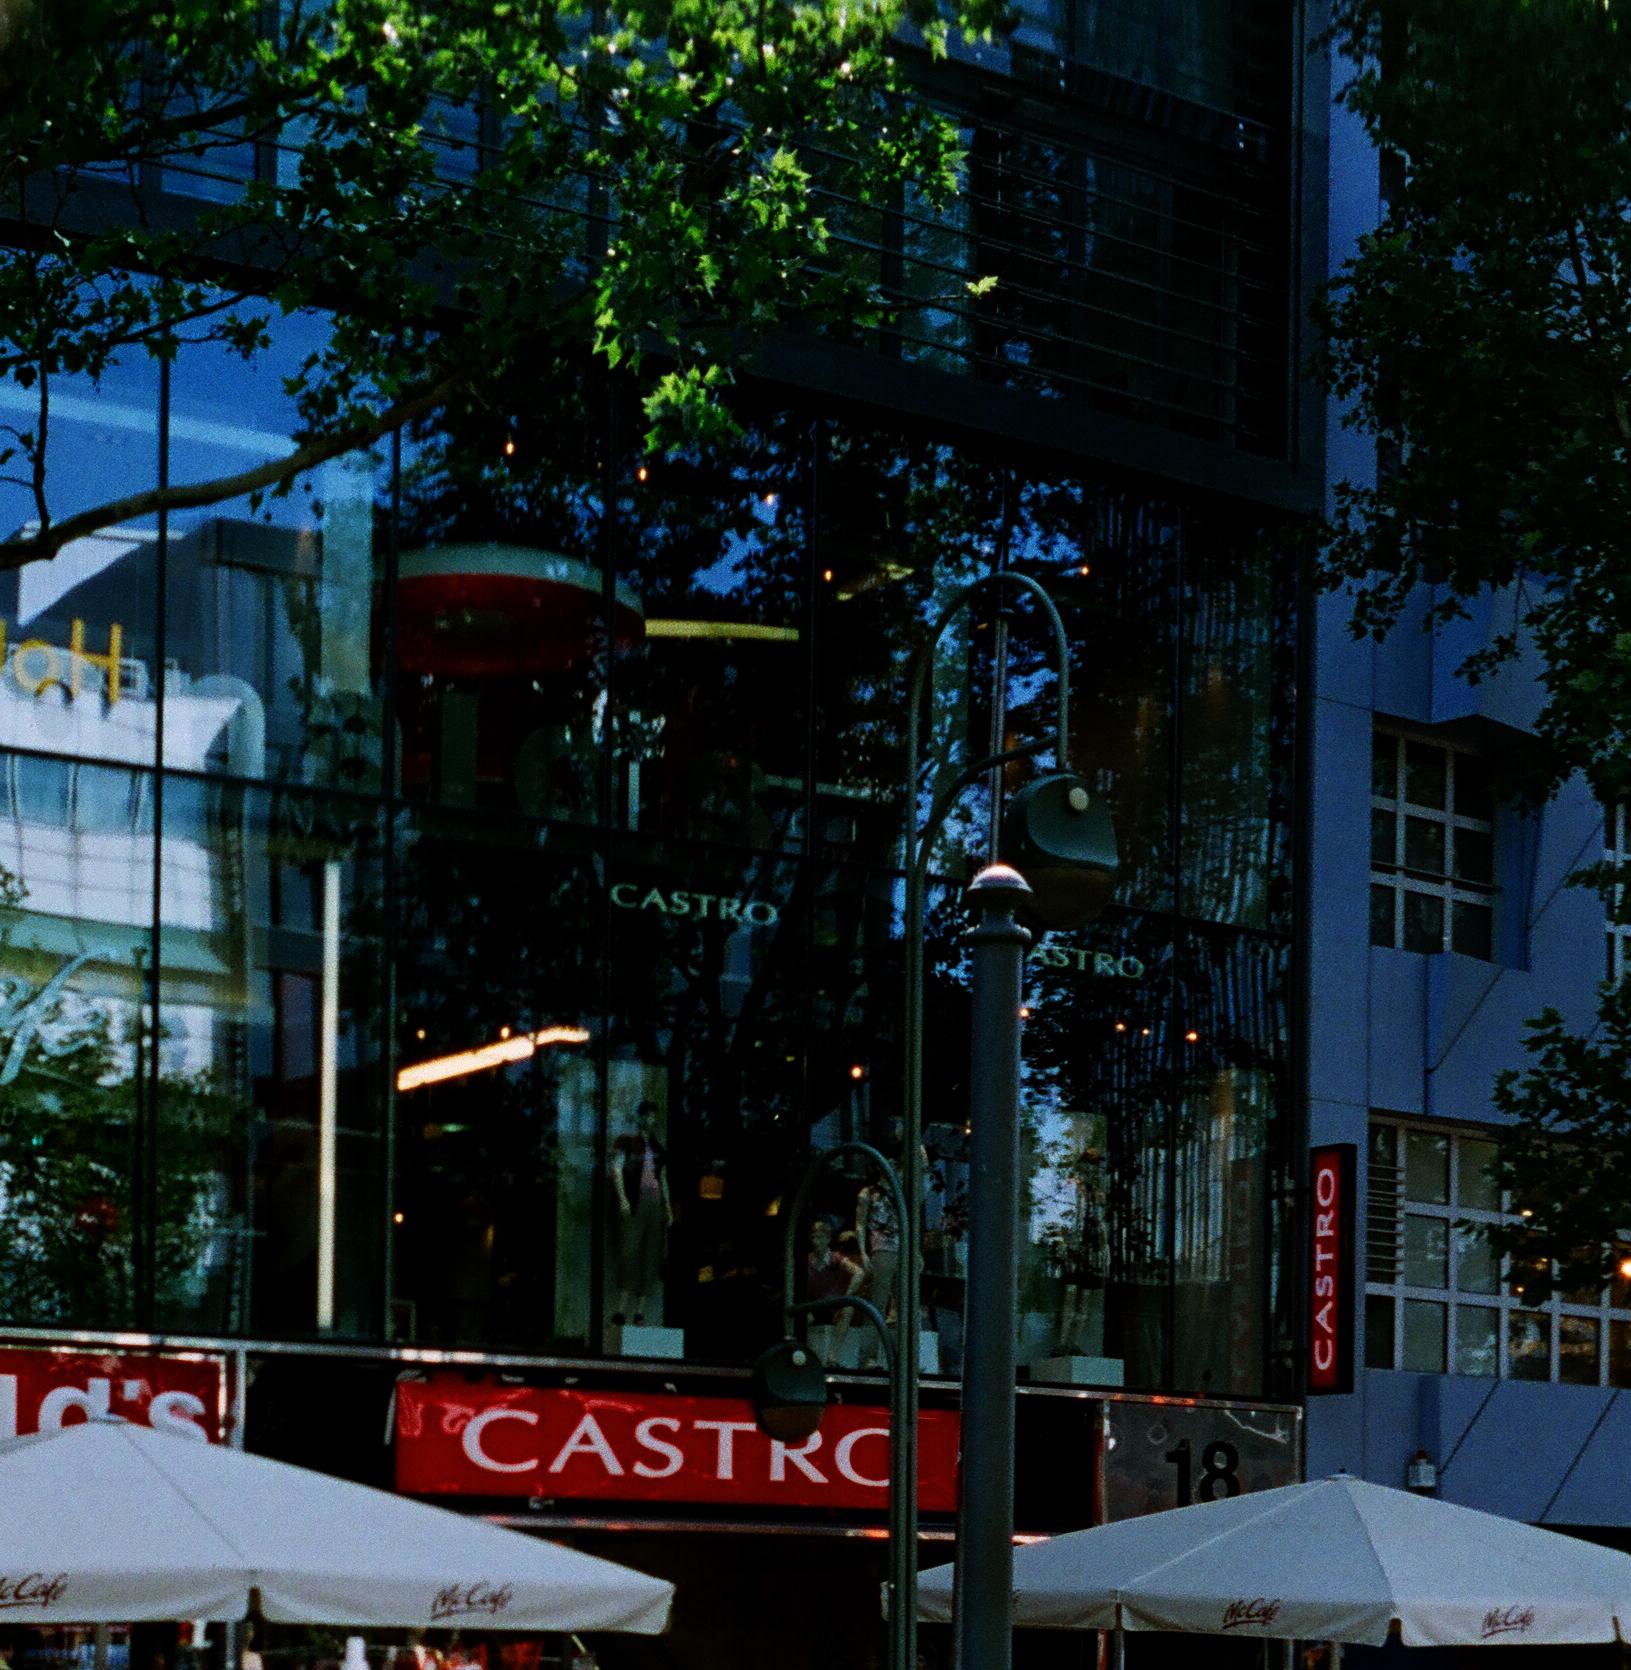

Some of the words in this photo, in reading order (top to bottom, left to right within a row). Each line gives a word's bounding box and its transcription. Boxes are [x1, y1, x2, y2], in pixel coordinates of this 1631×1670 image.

[610, 882, 779, 926] CASTRO
[1026, 942, 1145, 979] ASTRO
[1314, 1168, 1335, 1370] CASTRO
[461, 1408, 891, 1488] CASTRO
[1166, 1440, 1241, 1507] 18
